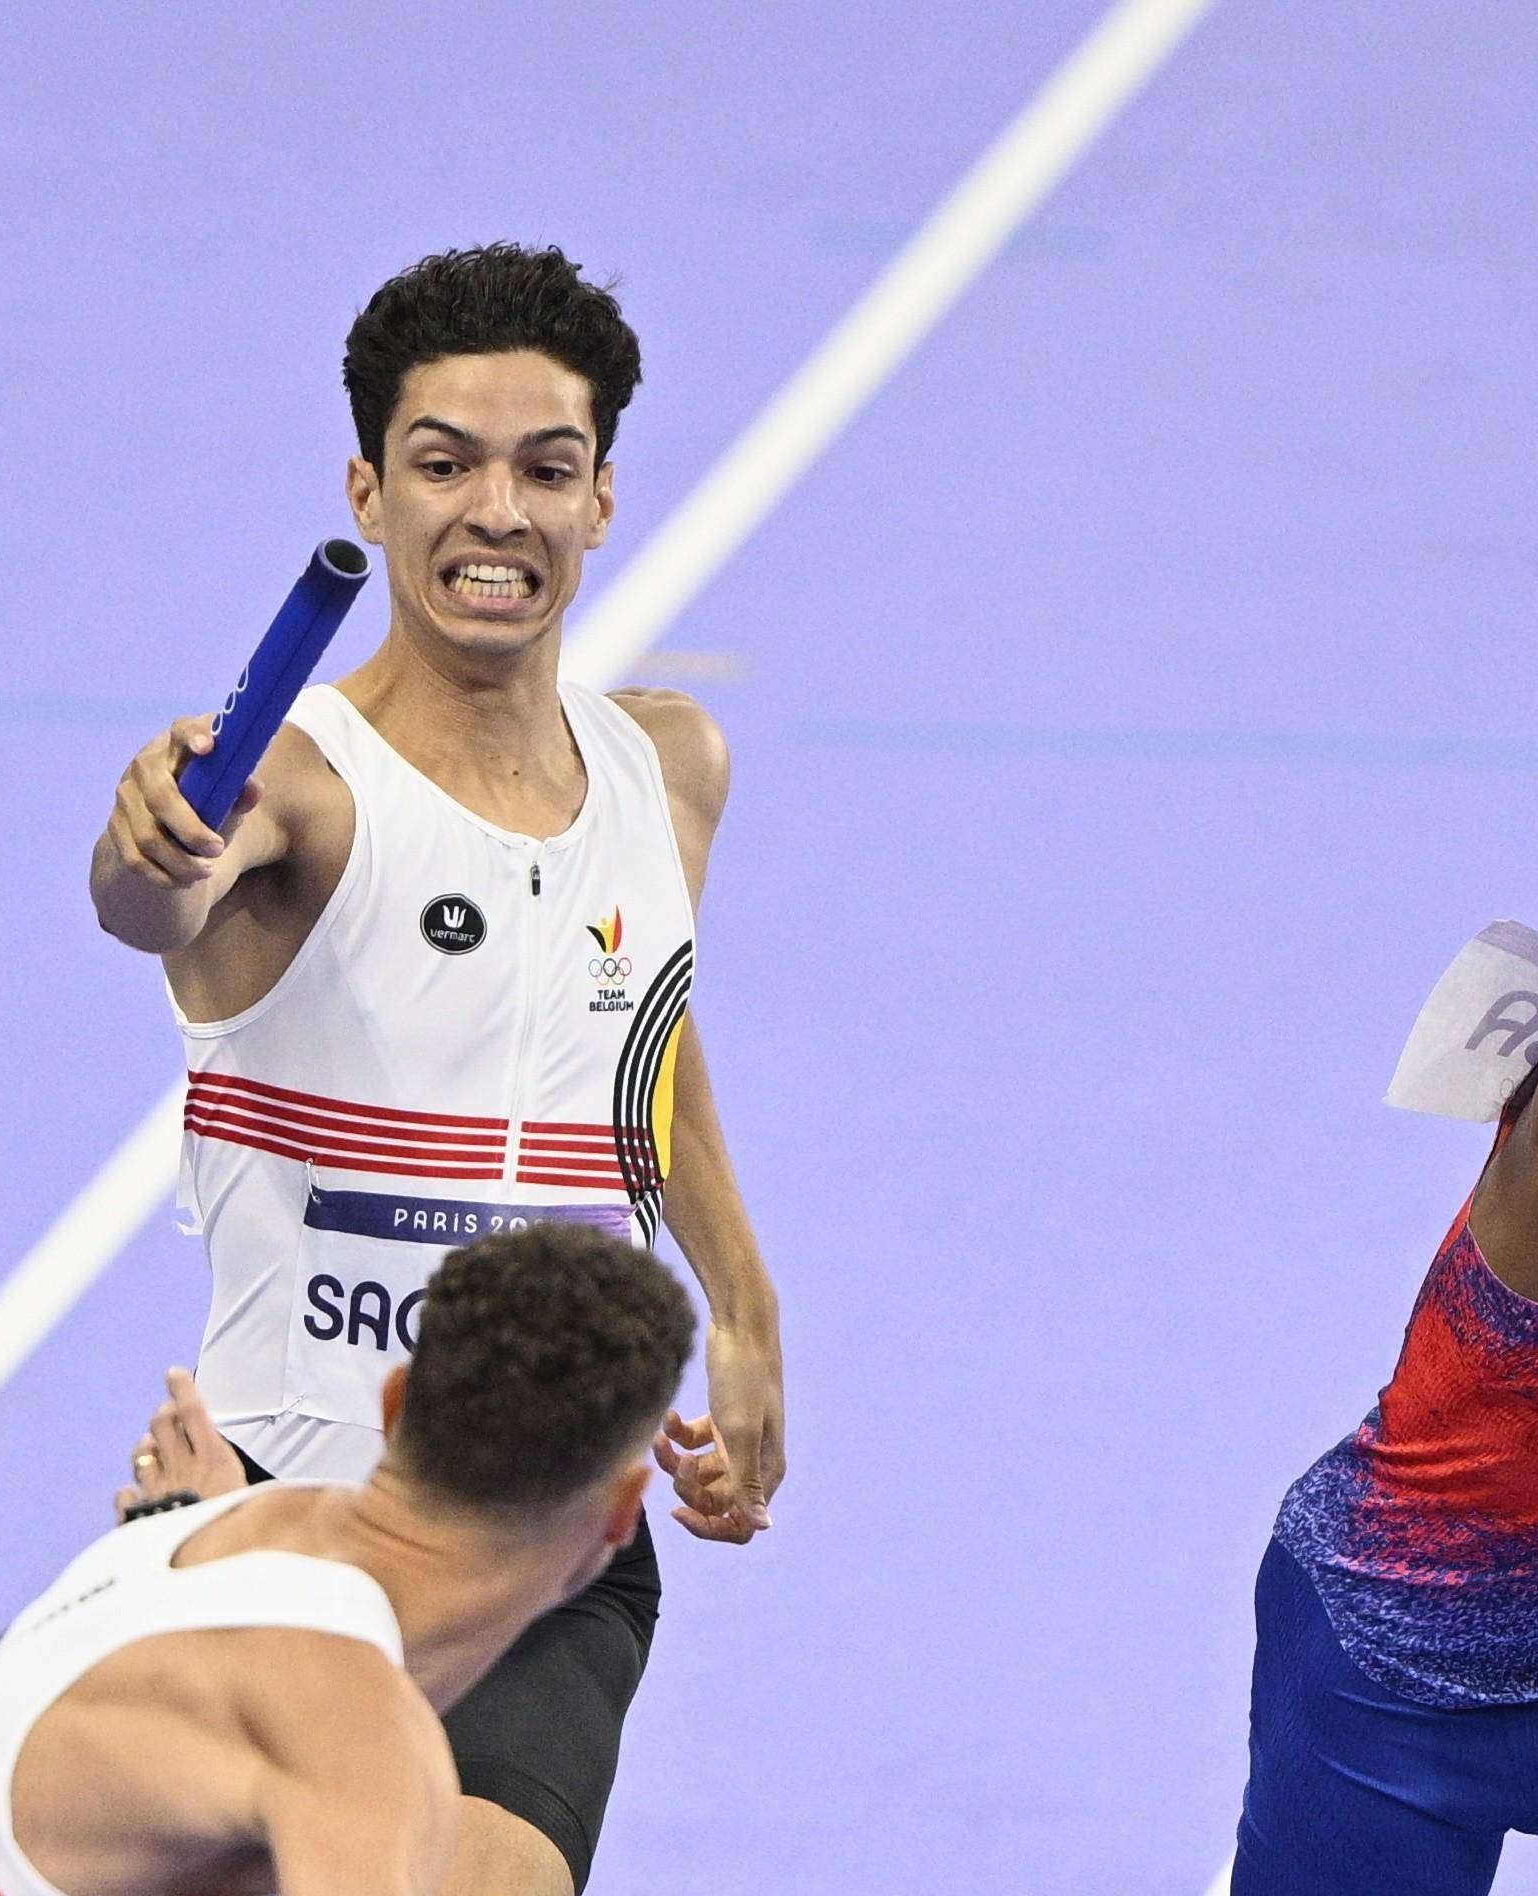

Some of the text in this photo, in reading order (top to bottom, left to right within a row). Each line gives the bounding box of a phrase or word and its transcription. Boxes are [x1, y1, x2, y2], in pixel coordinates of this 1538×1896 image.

[429, 928, 475, 943] vermarc
[597, 989, 626, 1000] TEAM
[589, 1000, 634, 1012] BELGIUM
[393, 1208, 478, 1233] PARIS
